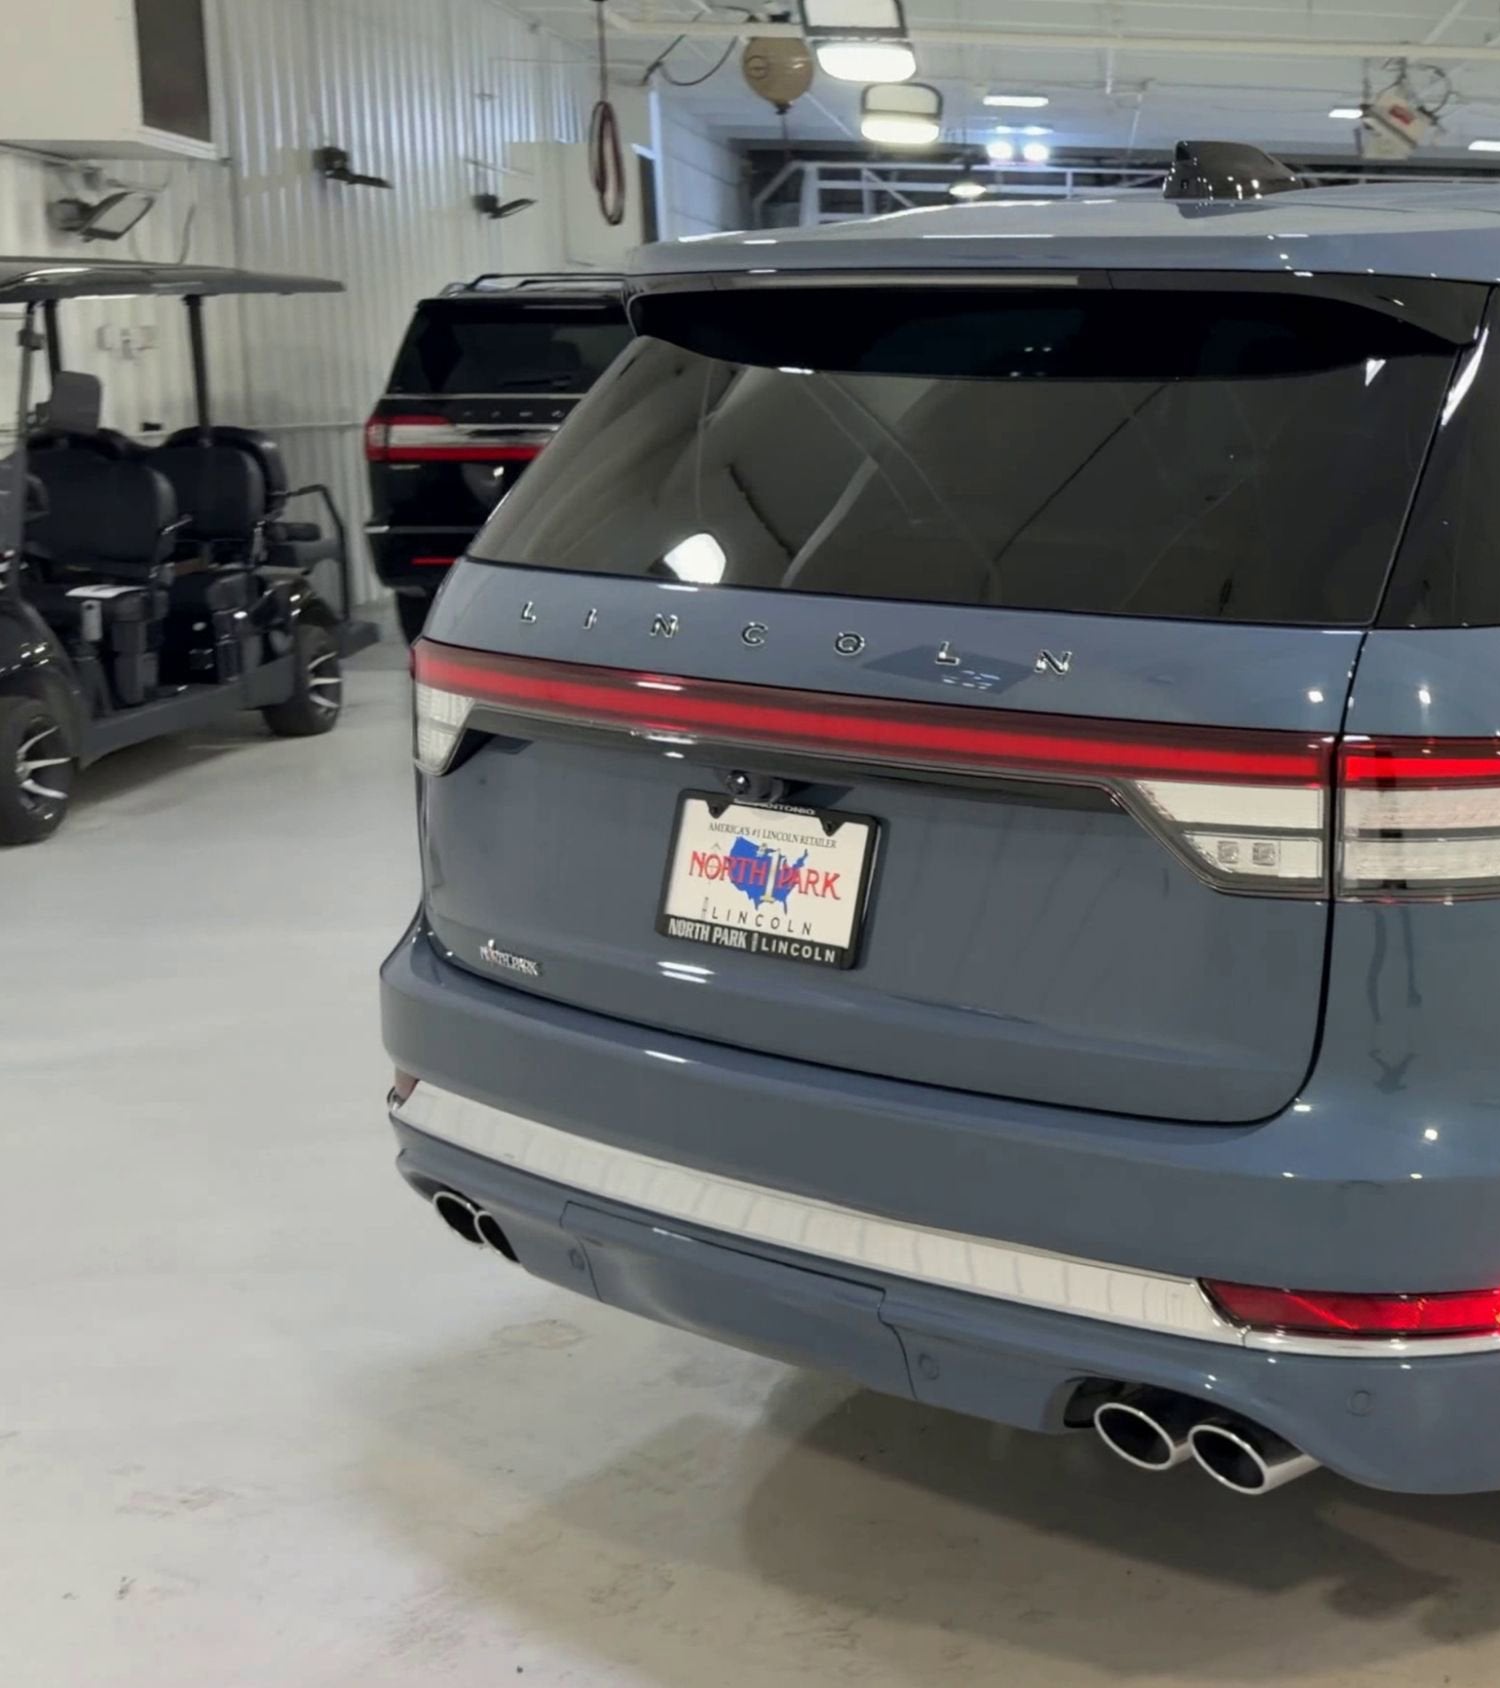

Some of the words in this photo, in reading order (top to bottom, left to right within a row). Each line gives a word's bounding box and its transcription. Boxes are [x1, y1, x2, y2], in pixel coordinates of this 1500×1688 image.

[520, 600, 1073, 675] LINCOLN
[708, 822, 751, 836] AMERICA'S
[762, 829, 799, 845] LINCOLN
[799, 836, 837, 849] RETAILER
[688, 850, 768, 886] NORTH
[778, 863, 841, 900] PARK
[668, 917, 711, 942] NORTH
[712, 925, 749, 949] PARK
[760, 937, 836, 963] LINCOLN
[711, 906, 813, 936] LINCOLN
